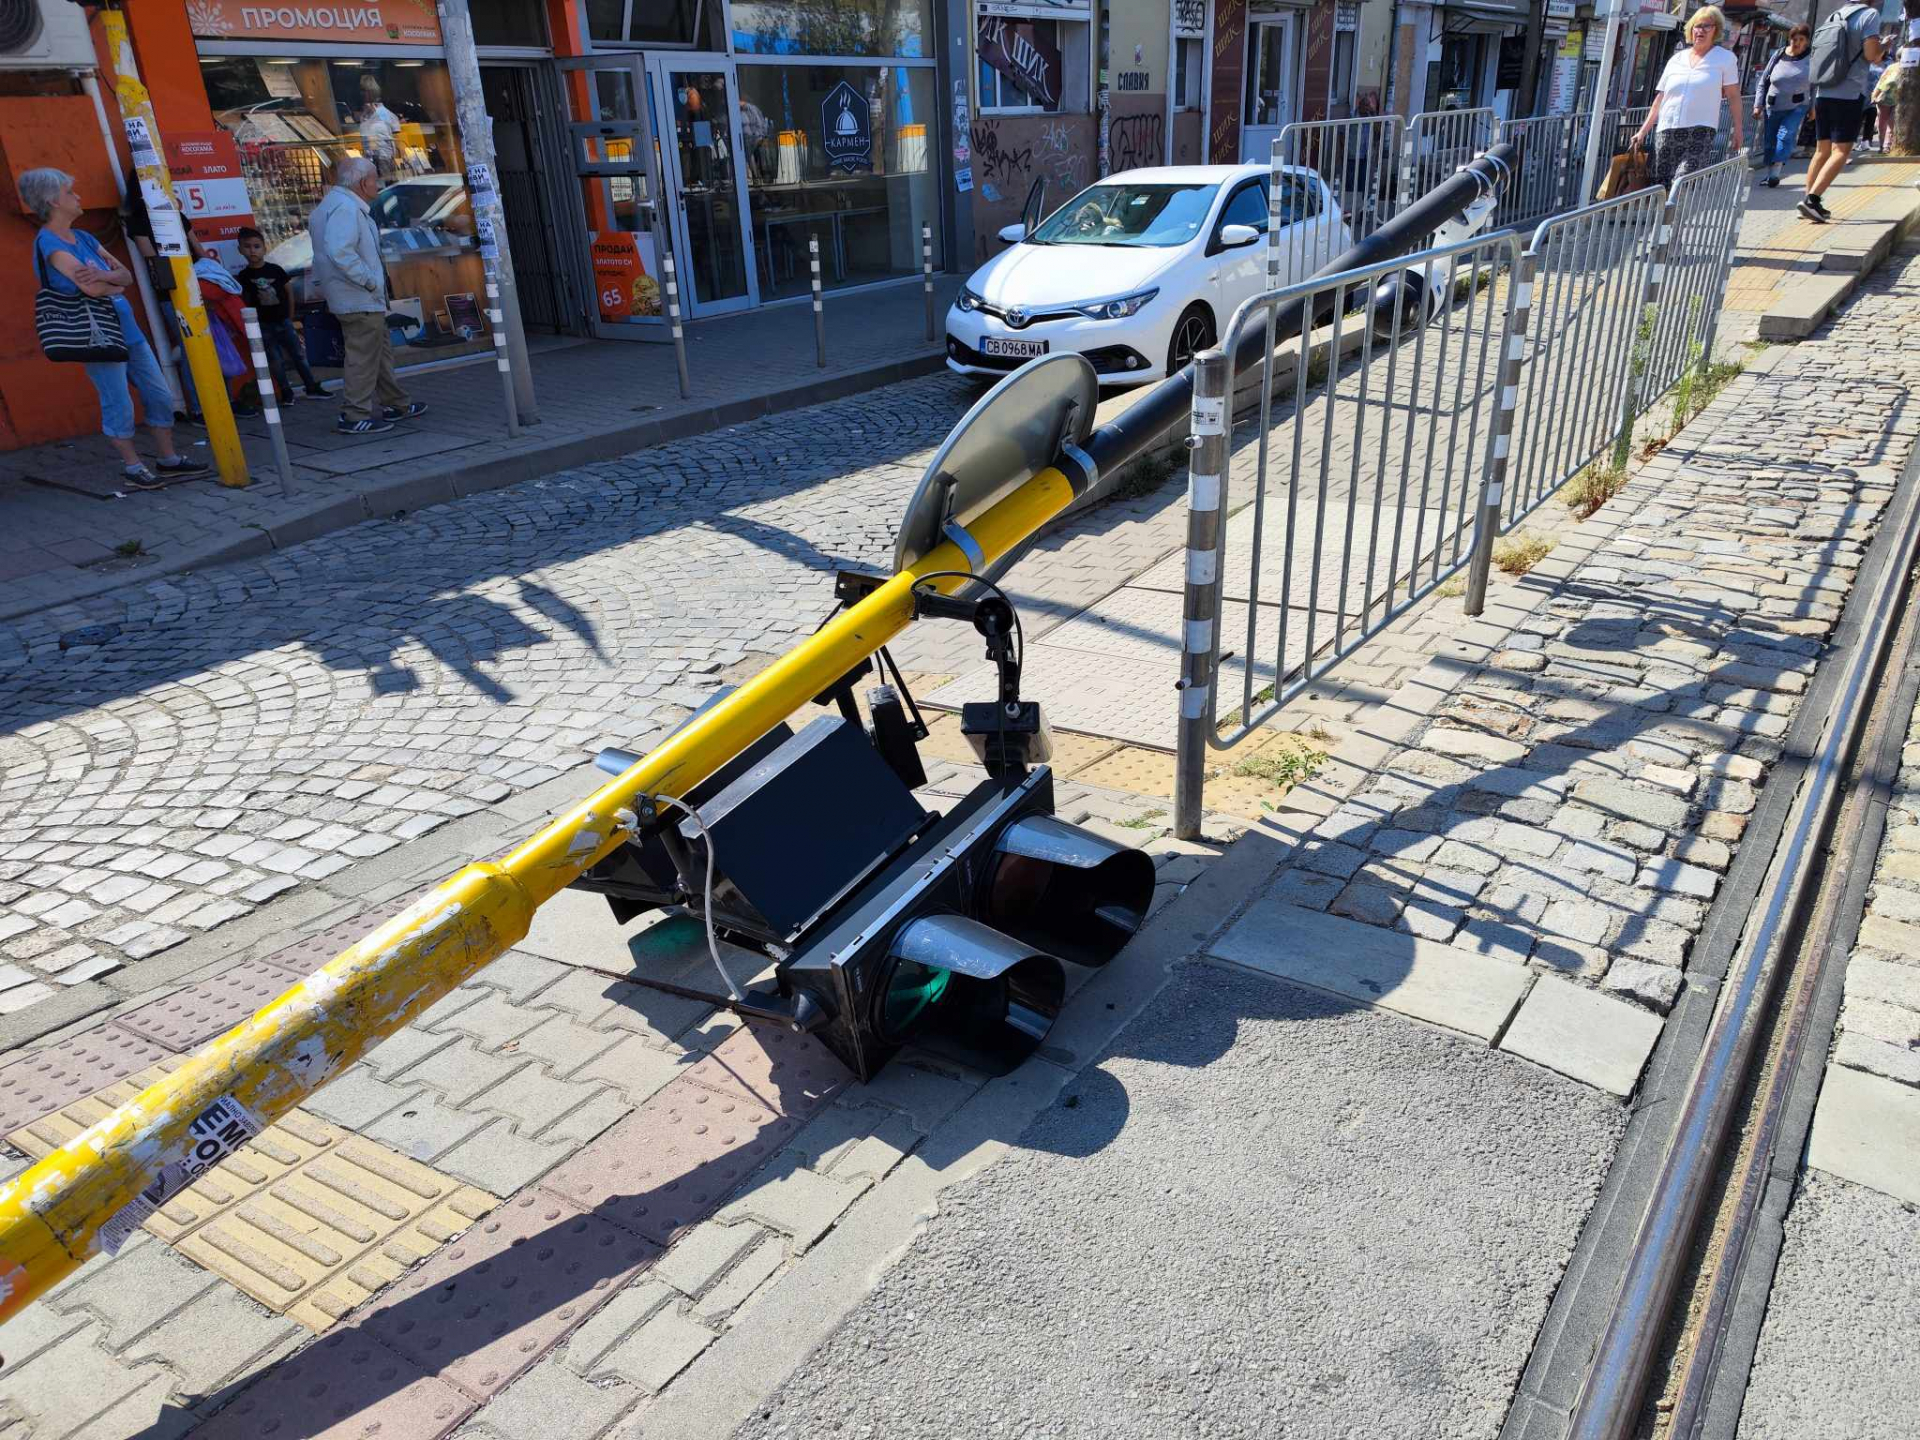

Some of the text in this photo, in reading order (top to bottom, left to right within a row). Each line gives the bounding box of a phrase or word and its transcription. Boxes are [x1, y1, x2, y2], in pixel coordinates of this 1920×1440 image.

[241, 7, 383, 31] ПРОМОЦИЯ
[1215, 24, 1241, 59] ШИК
[1308, 30, 1329, 60] ШИК
[1012, 32, 1055, 103] ШИК
[1213, 111, 1238, 143] ШИК
[831, 136, 865, 148] КАРМЕН
[203, 165, 227, 174] ЗЛАТО
[603, 289, 622, 307] 65
[987, 341, 1042, 356] CB 0968 MA
